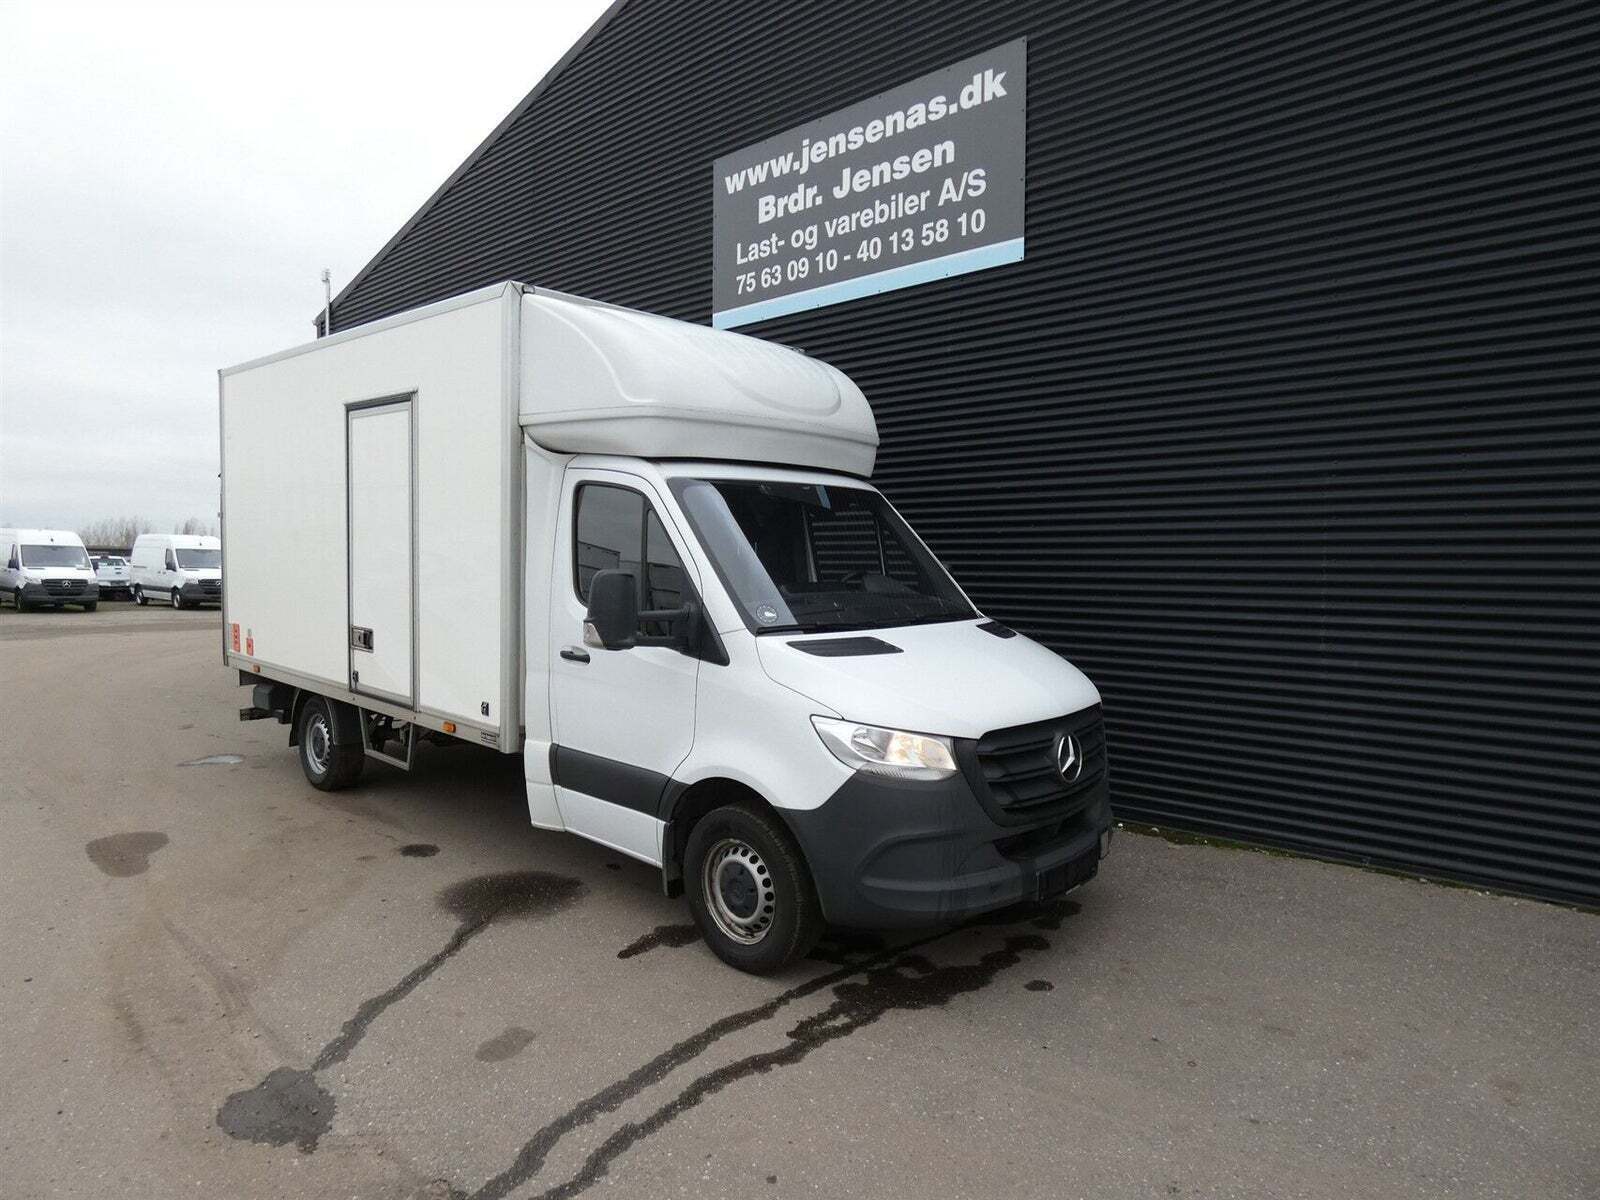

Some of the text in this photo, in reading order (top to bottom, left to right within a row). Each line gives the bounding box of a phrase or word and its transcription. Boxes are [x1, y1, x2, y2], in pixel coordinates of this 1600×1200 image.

[724, 68, 1008, 195] www.jensenas.dk
[735, 168, 987, 266] Last- og varebiler A/S
[757, 139, 955, 225] Brdr. Jensen
[735, 271, 757, 296] 75
[760, 264, 783, 289] 63
[786, 256, 810, 282] 09
[814, 248, 838, 274] 10
[856, 236, 882, 263] 40
[888, 227, 915, 255] 13
[921, 218, 949, 247] 58
[956, 208, 986, 237] 10
